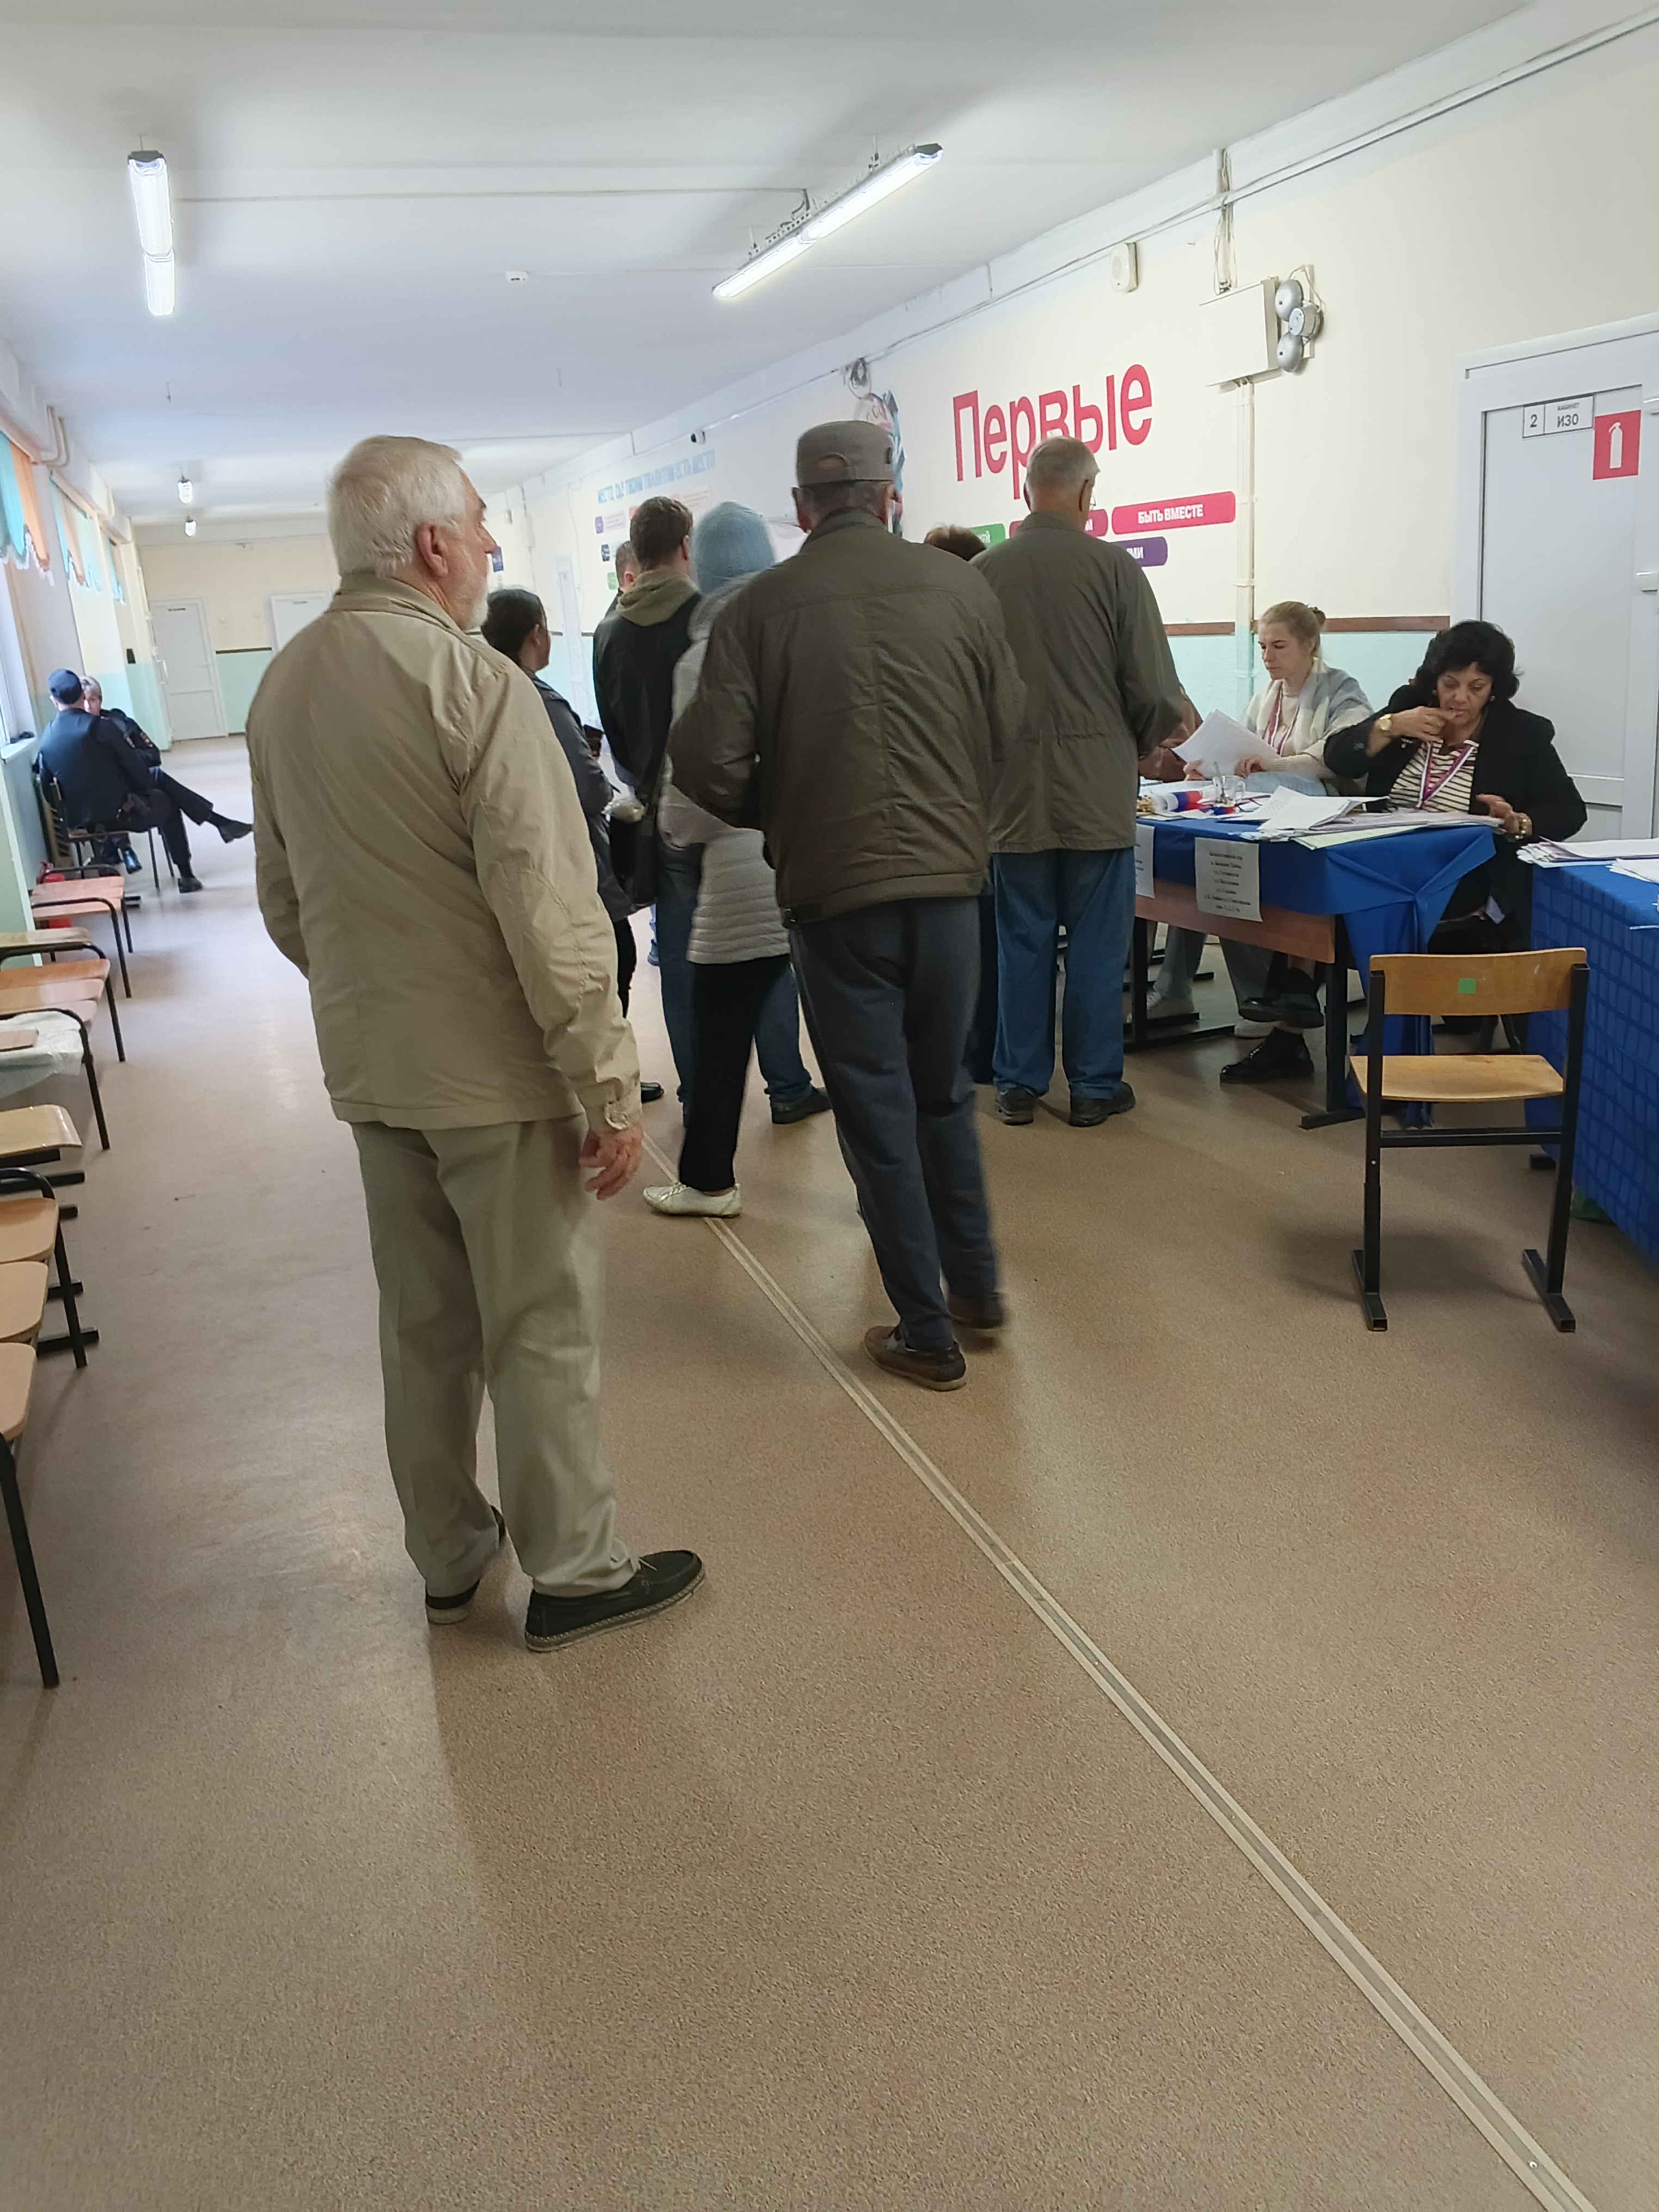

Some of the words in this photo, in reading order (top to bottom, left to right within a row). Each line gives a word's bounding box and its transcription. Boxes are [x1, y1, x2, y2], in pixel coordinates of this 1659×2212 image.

[1530, 414, 1538, 428] 2
[1557, 413, 1579, 428] ИЗО
[953, 364, 1152, 500] Первые
[1137, 509, 1164, 524] БЫТЬ
[1164, 503, 1204, 521] ВМЕСТЕ
